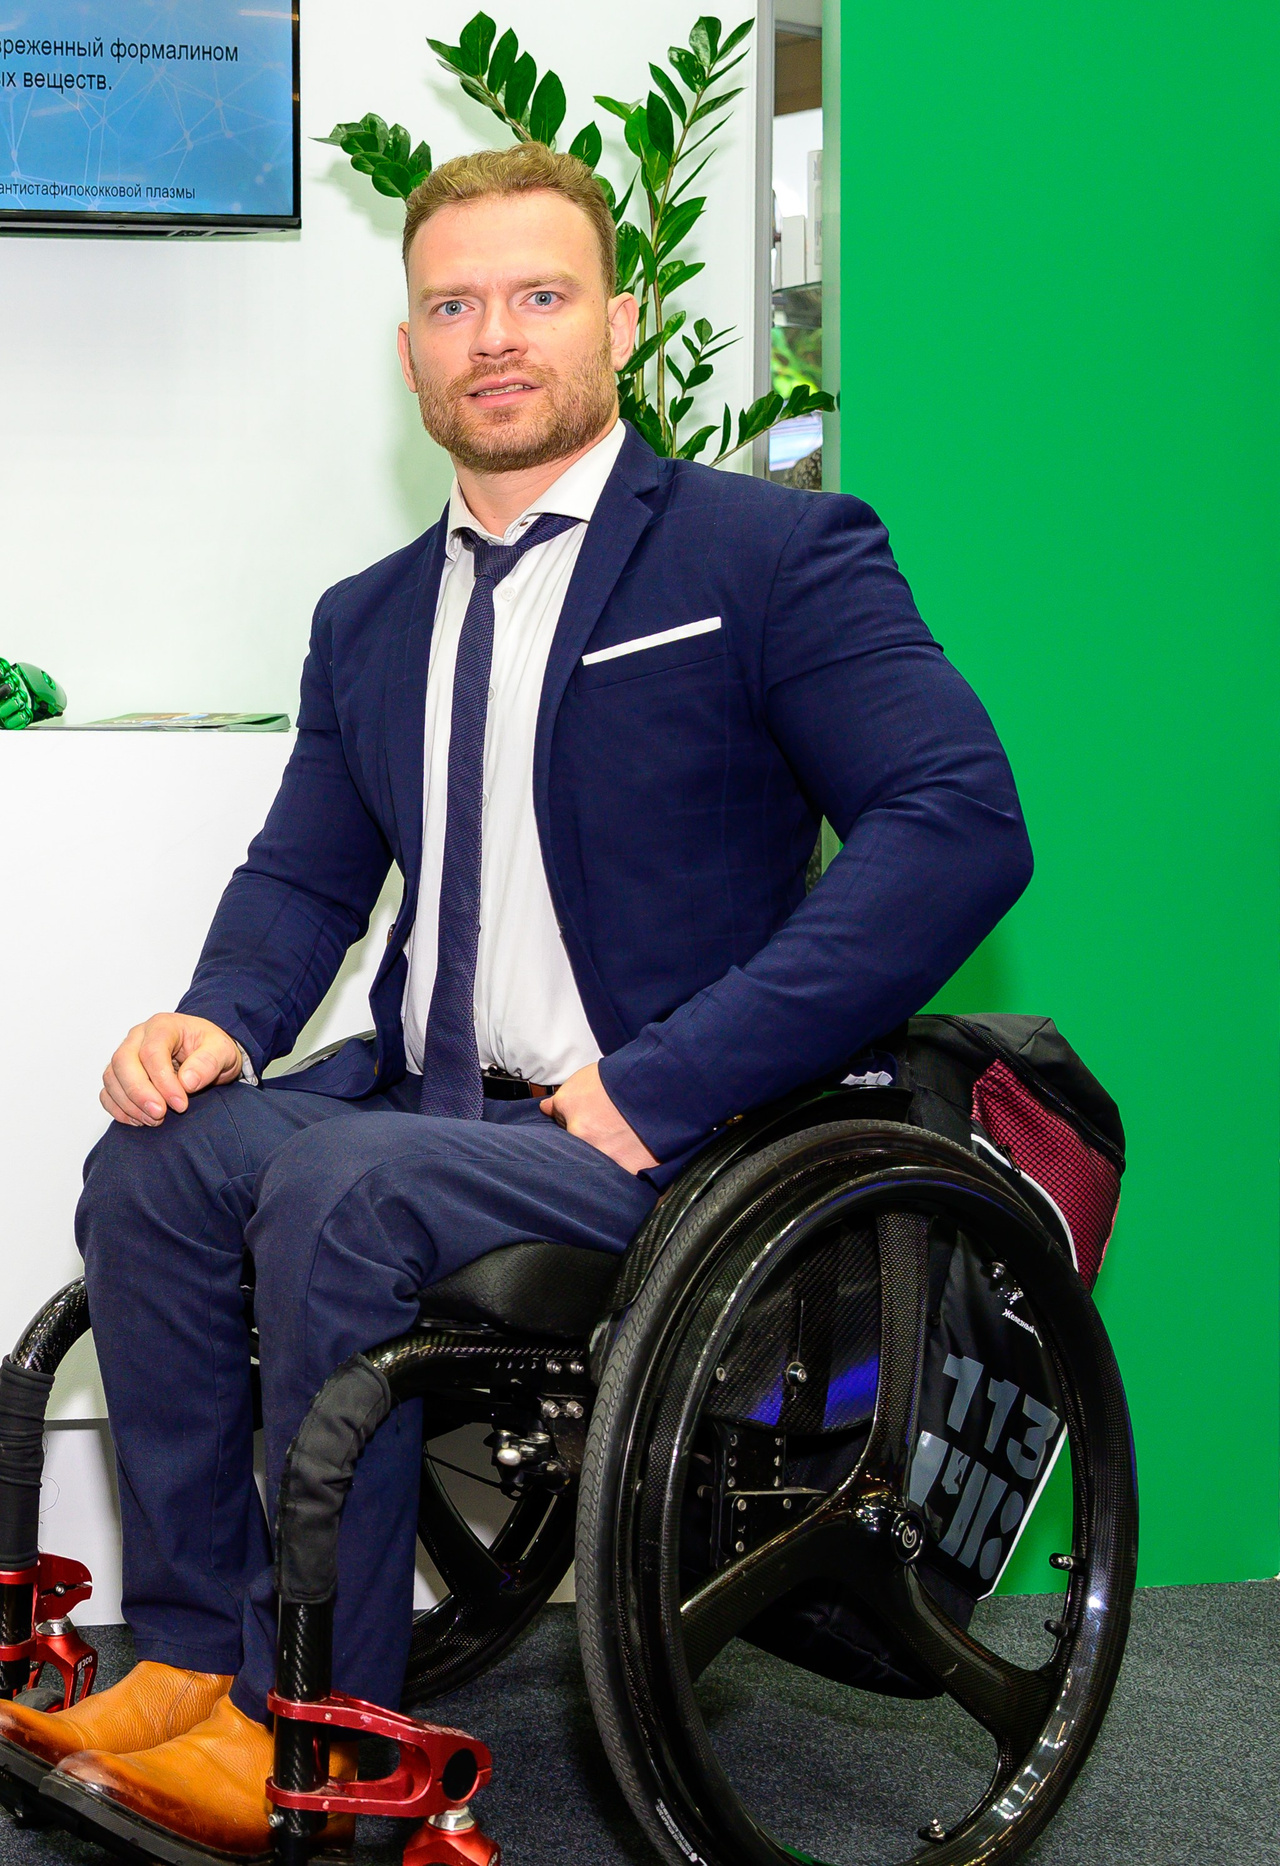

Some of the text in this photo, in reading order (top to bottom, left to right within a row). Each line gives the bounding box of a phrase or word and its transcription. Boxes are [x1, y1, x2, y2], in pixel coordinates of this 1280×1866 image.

[110, 37, 239, 64] формалином
[23, 71, 112, 93] веществ.
[145, 186, 196, 199] плазмы
[941, 1353, 1061, 1482] 113
